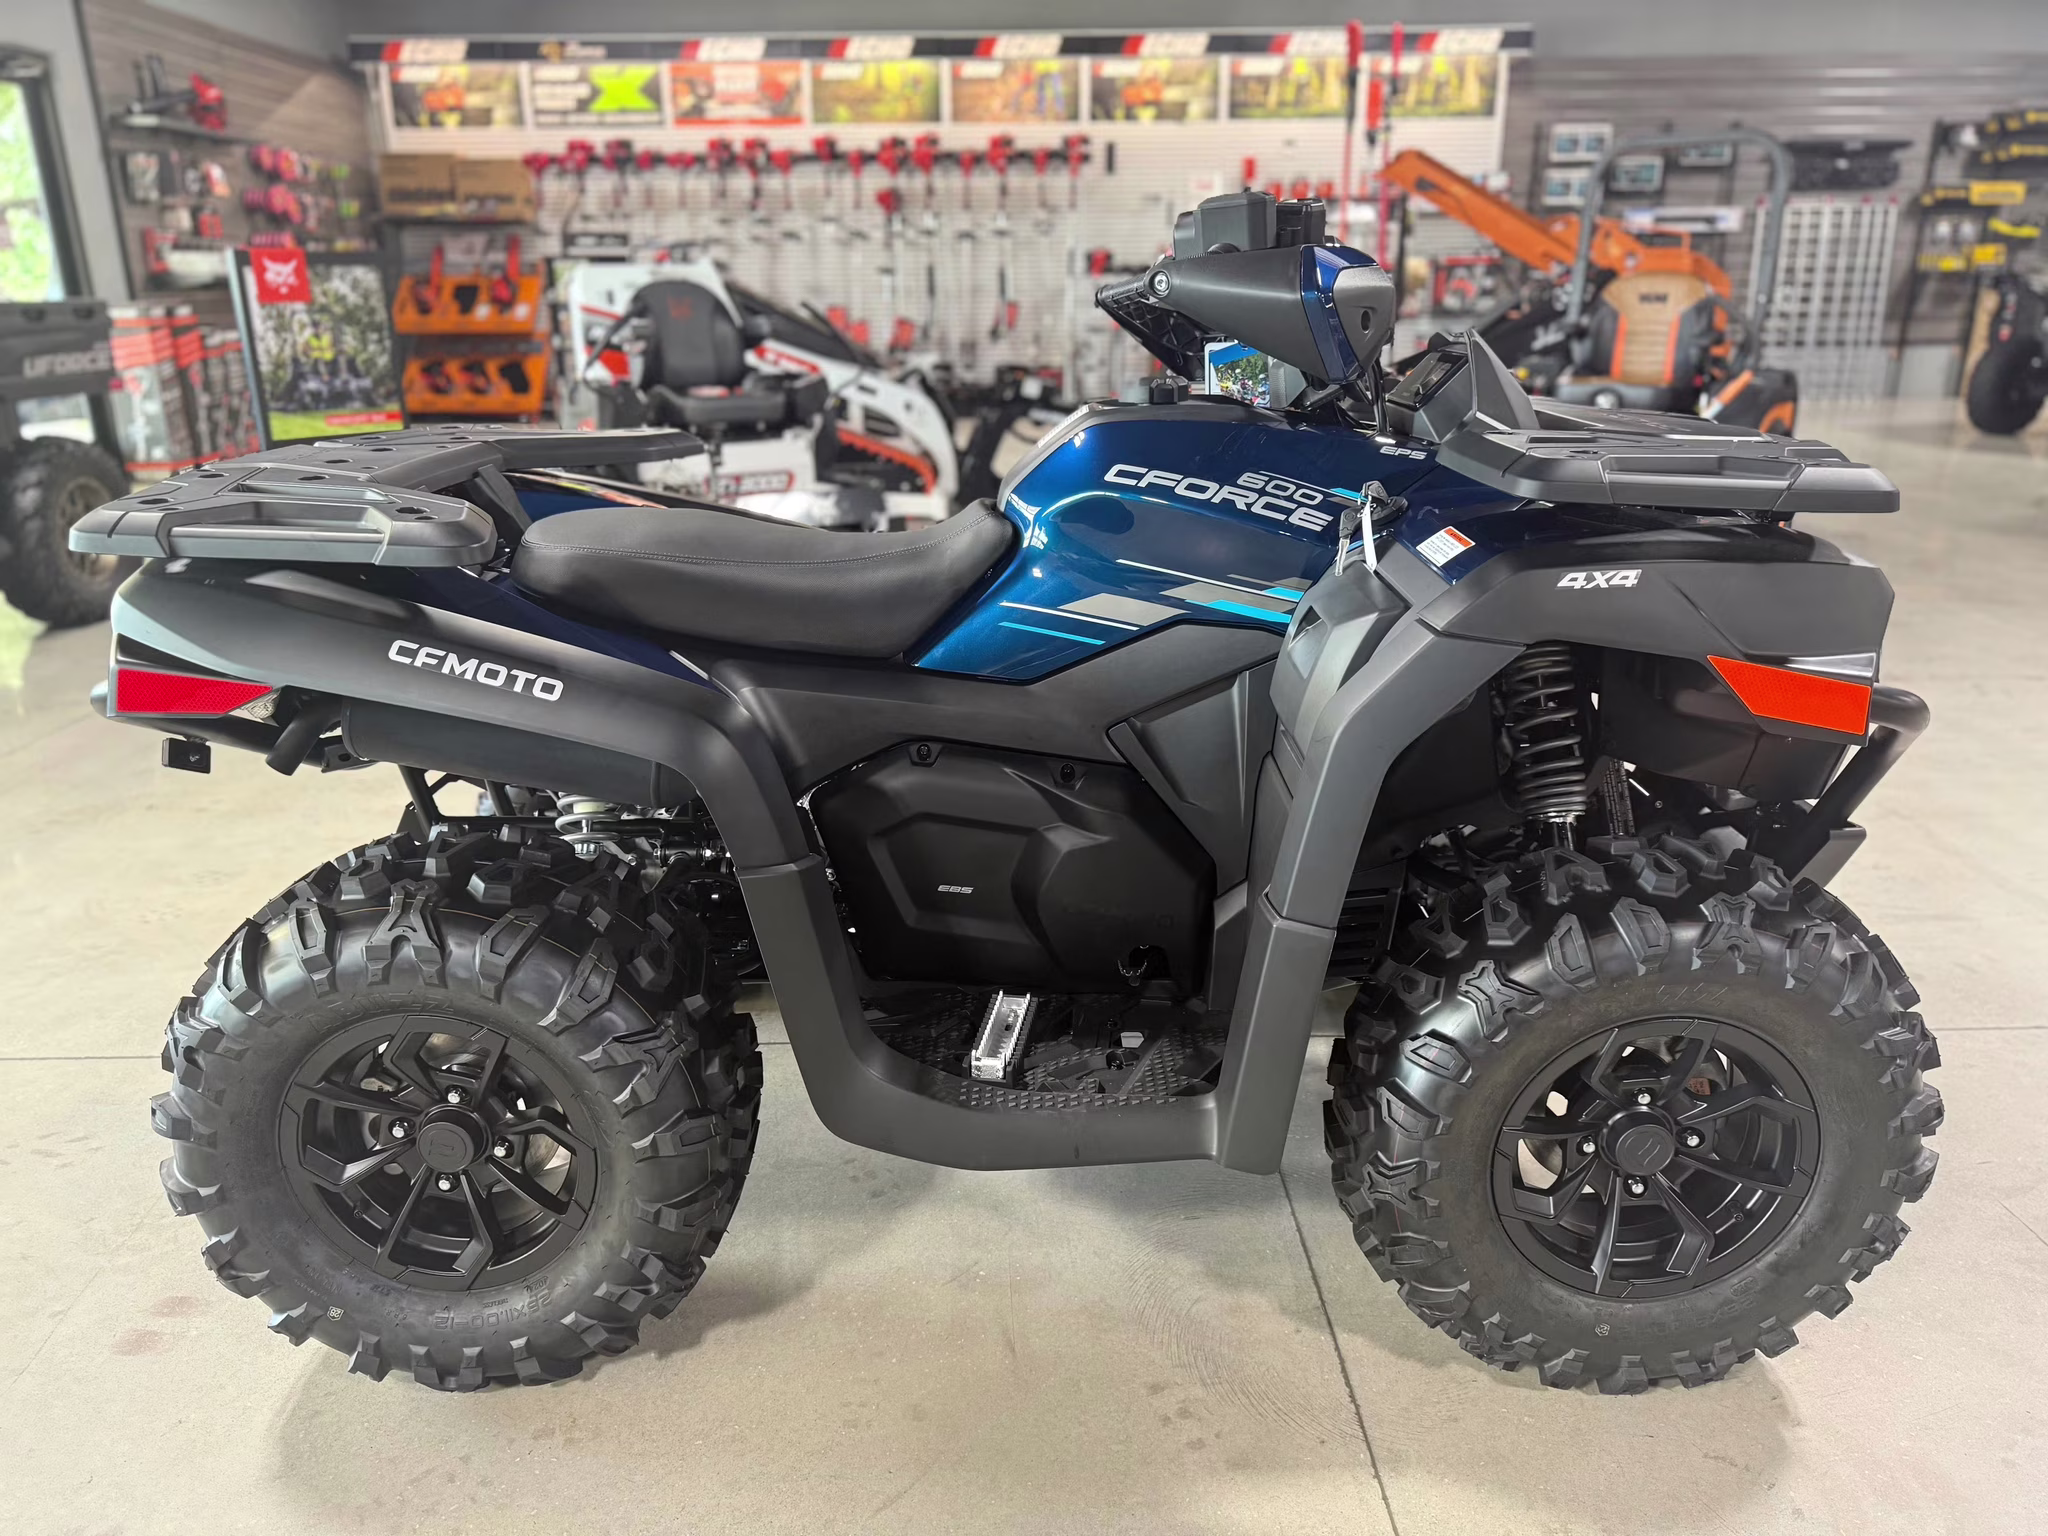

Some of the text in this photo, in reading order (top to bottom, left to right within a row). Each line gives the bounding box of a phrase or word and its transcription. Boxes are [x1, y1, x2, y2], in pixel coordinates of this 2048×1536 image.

[1380, 444, 1428, 460] EPS
[1103, 463, 1334, 532] CFORCE
[1236, 471, 1325, 506] 600
[1557, 569, 1642, 589] 4X4
[388, 638, 564, 702] CFMOTO
[937, 883, 974, 895] EBS
